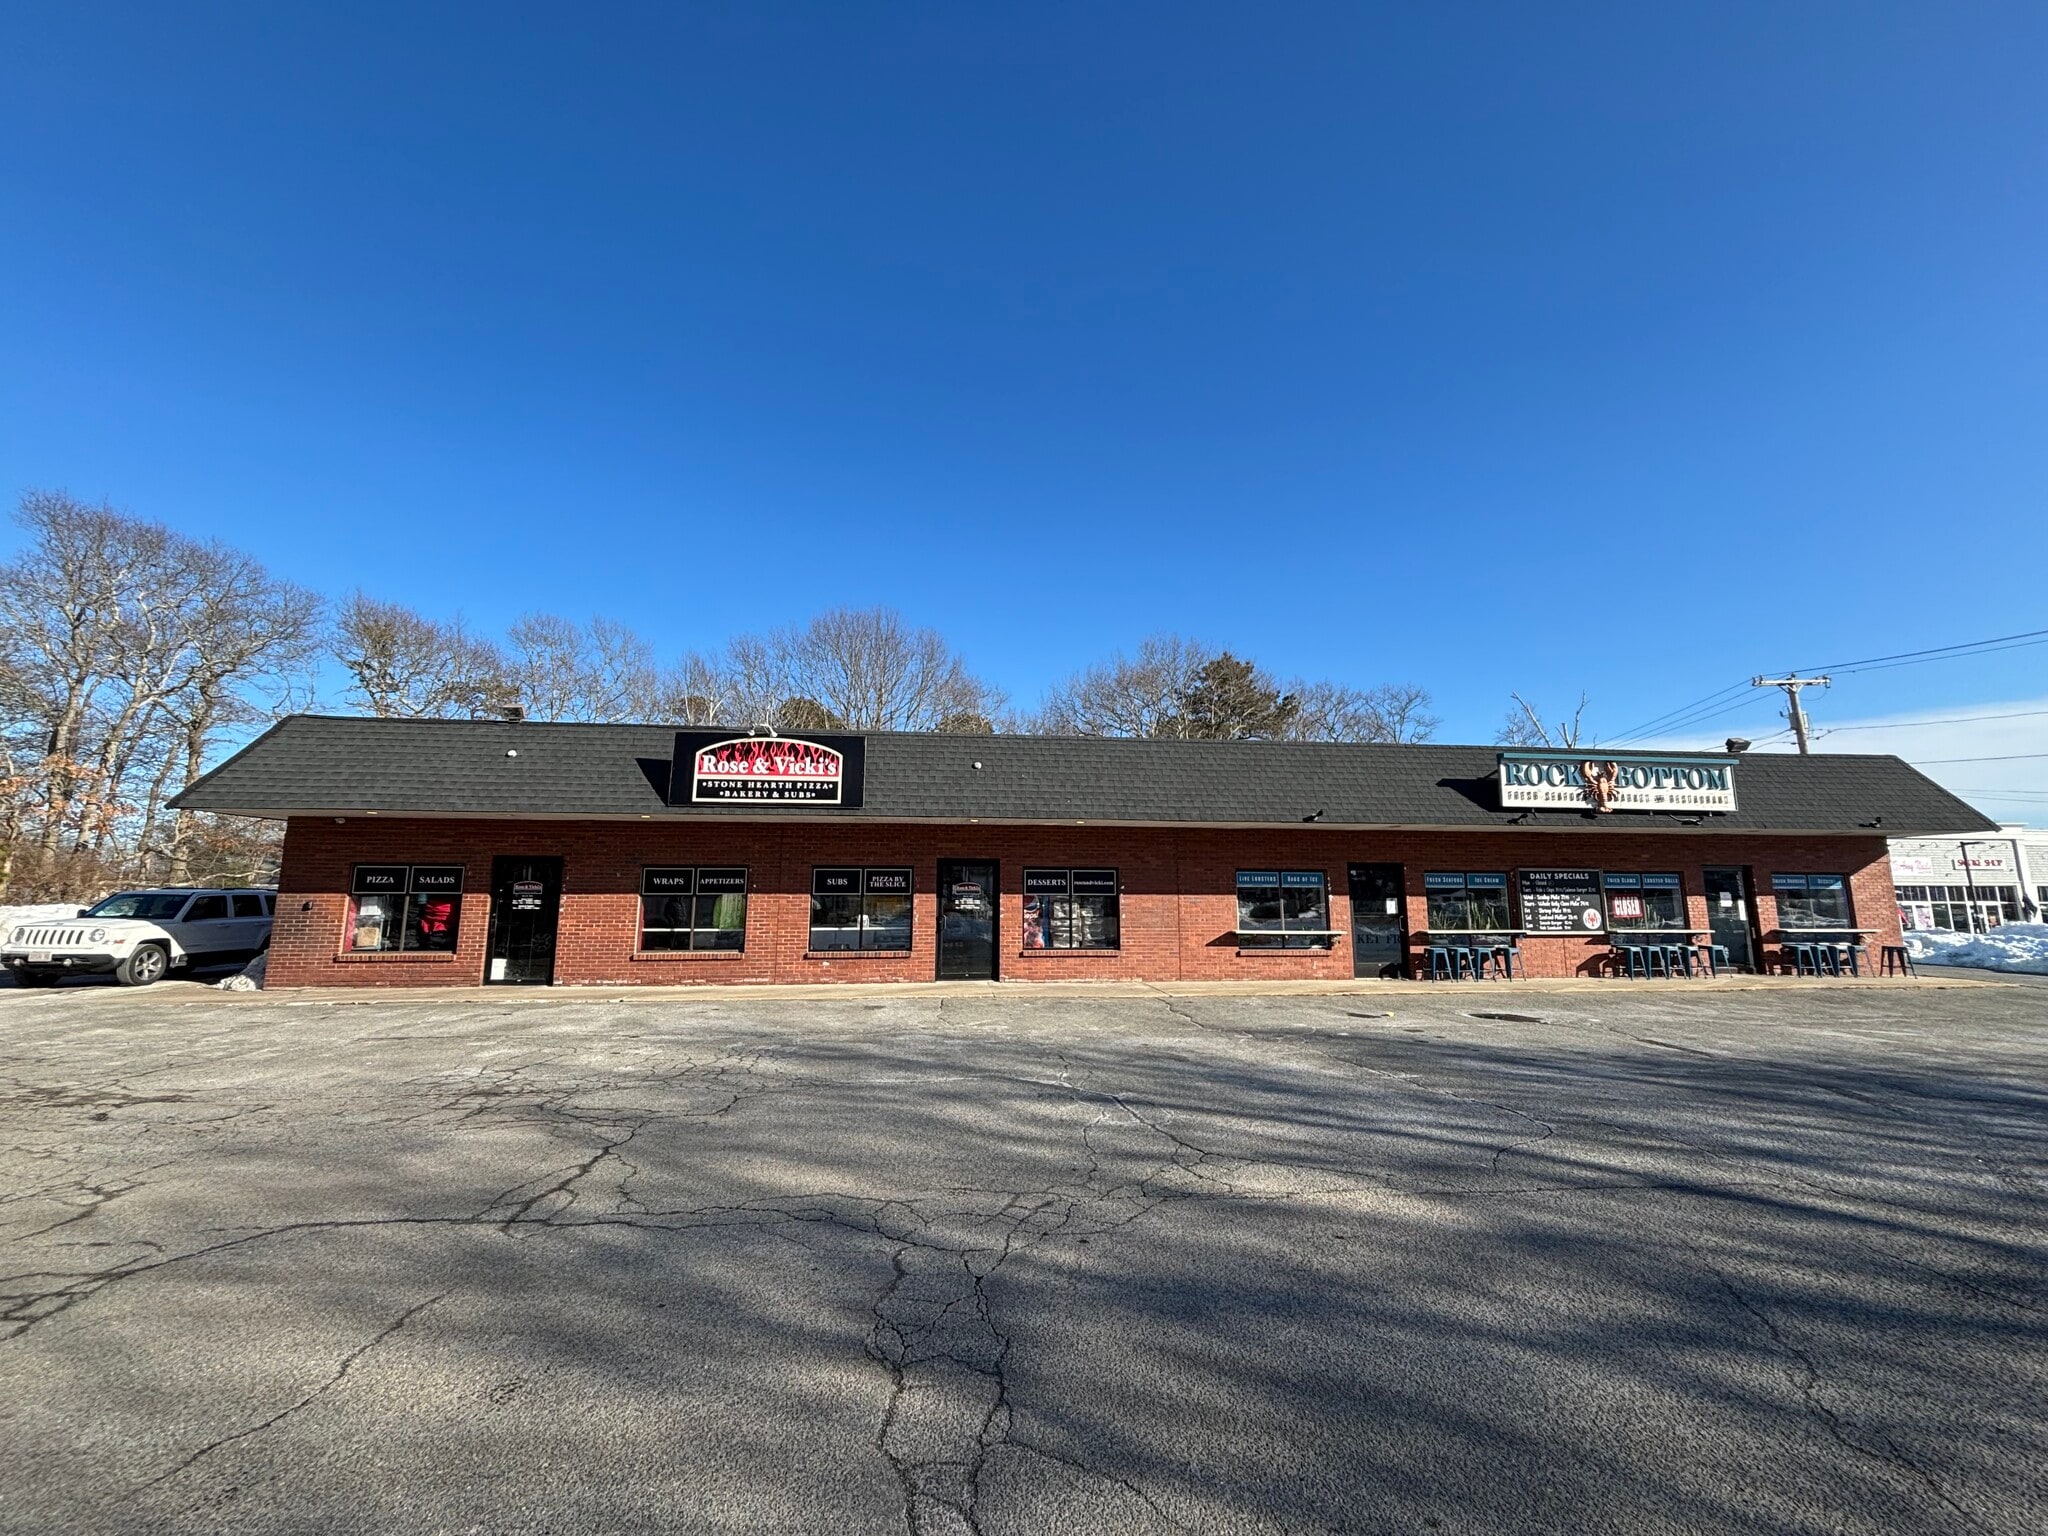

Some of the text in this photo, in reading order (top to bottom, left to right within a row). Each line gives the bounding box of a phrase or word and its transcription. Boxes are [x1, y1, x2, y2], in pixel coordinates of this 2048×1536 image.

[701, 755, 837, 775] Rose & Vicki's
[1504, 763, 1730, 791] ROCK BOTTOM
[419, 876, 455, 884] SALADS
[653, 877, 684, 885] WRAPS
[827, 878, 848, 886] SUBS
[1614, 896, 1640, 916] CLOSED
